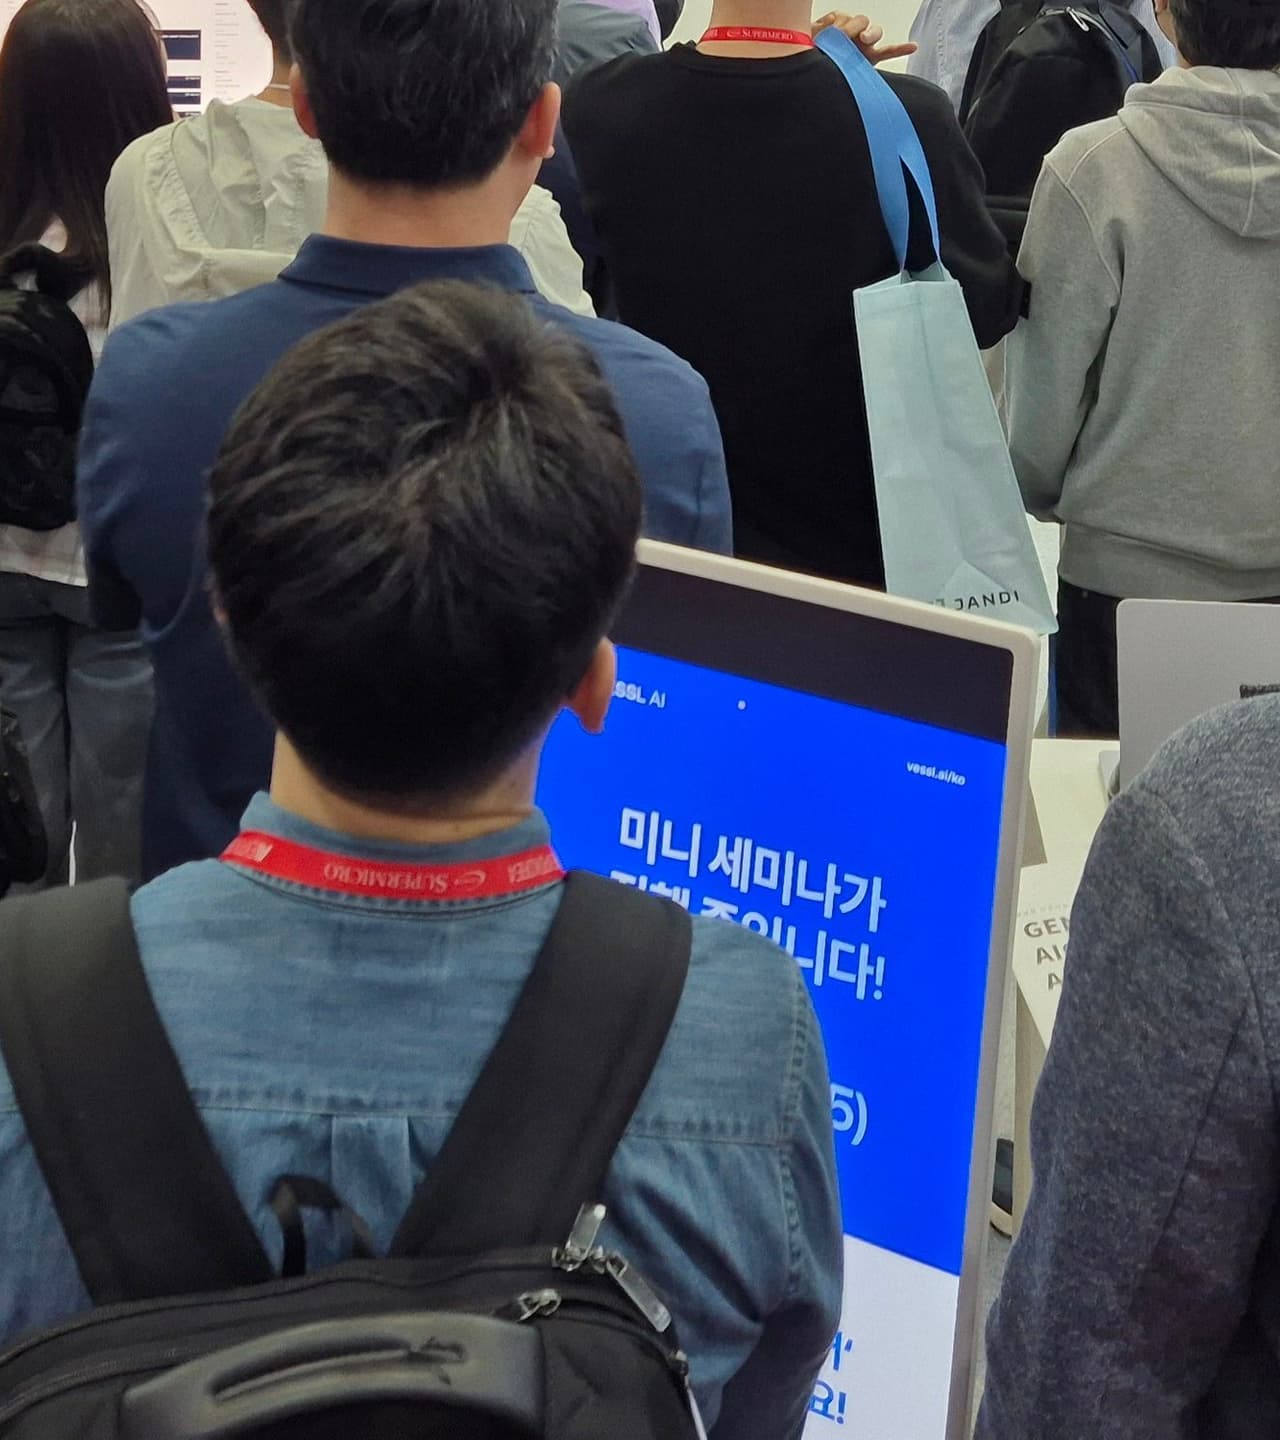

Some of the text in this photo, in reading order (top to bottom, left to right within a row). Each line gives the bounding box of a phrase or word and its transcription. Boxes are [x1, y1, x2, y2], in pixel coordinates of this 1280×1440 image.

[954, 590, 1019, 611] JANDI
[611, 680, 666, 709] SSL AI
[620, 806, 702, 878] 미니
[708, 834, 887, 934] 세미나가
